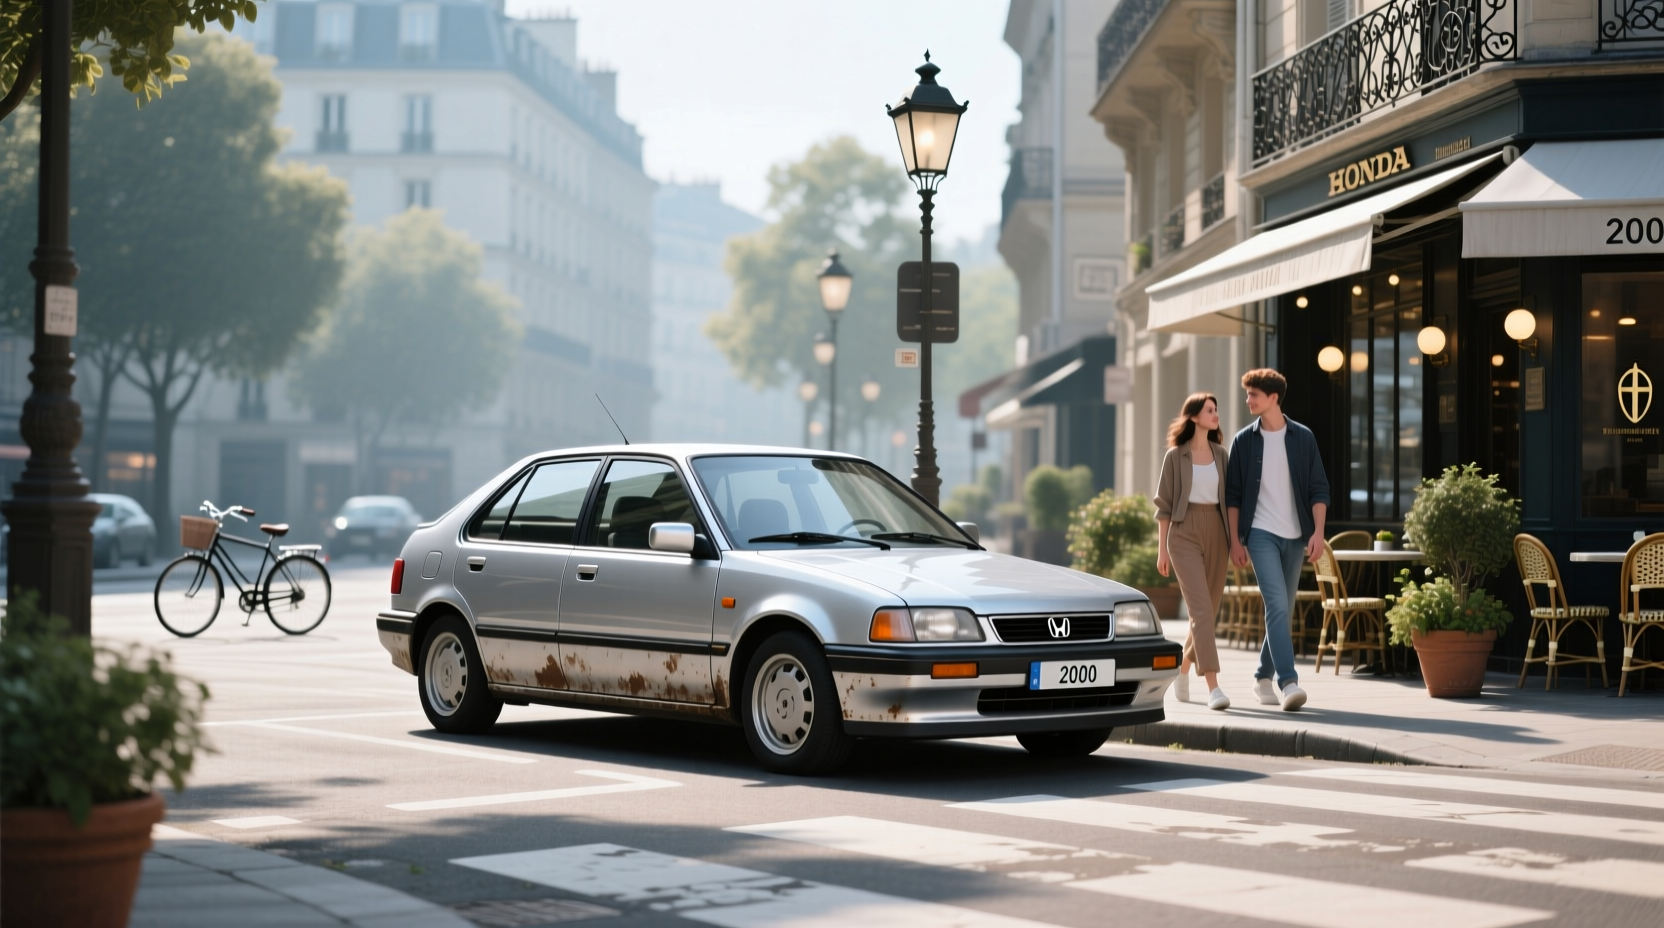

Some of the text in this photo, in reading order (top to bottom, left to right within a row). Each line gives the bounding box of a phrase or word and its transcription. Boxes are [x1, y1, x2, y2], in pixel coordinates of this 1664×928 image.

[1328, 145, 1411, 197] HONDA
[1606, 217, 1664, 245] 200
[1059, 664, 1097, 684] 2000
